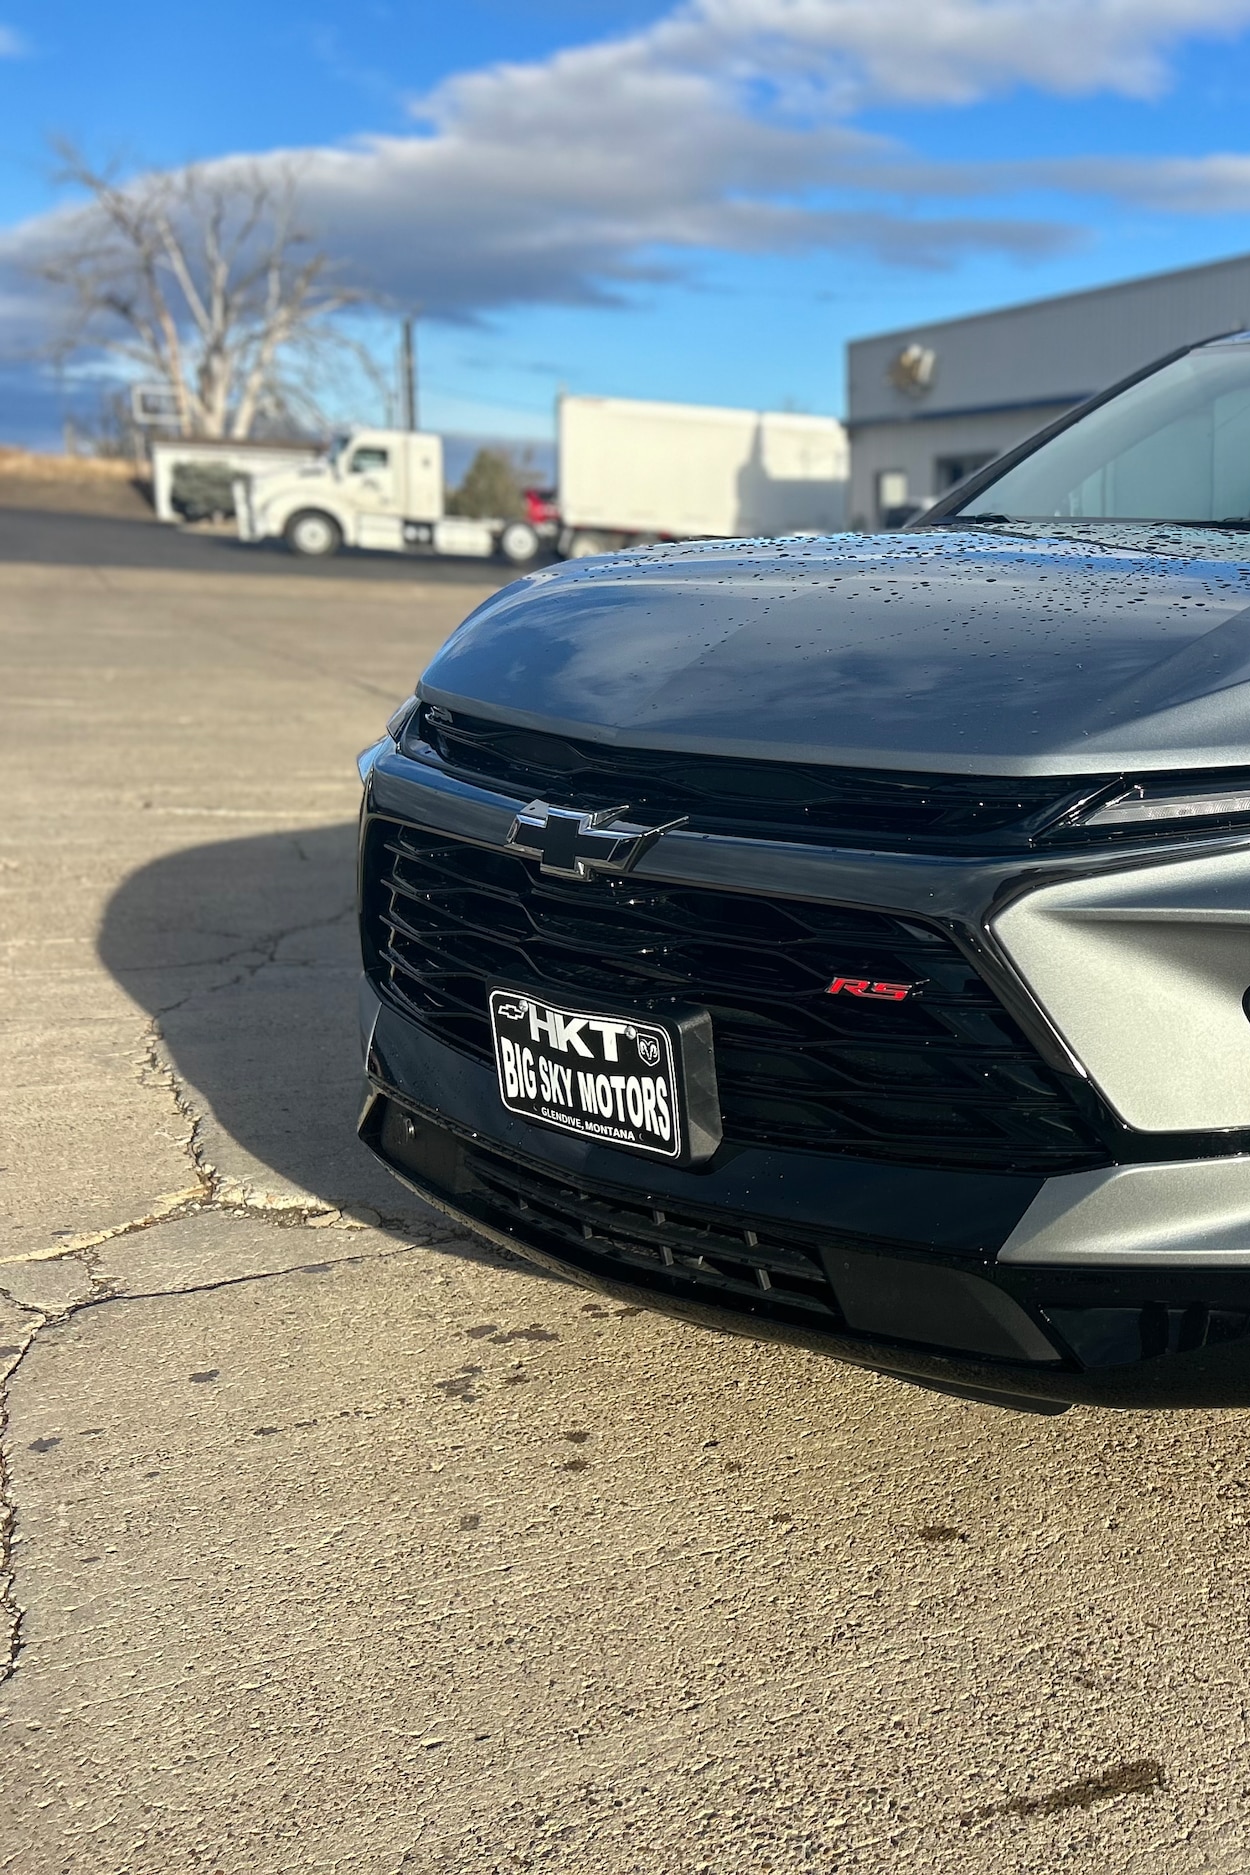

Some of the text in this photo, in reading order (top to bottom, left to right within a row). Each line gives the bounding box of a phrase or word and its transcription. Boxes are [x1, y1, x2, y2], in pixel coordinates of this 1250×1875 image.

[824, 977, 913, 1001] RS
[528, 1003, 627, 1063] HKT
[500, 1036, 671, 1141] BIG SKY MOTORS
[541, 1106, 636, 1141] GLENDIVE, MONTANA
